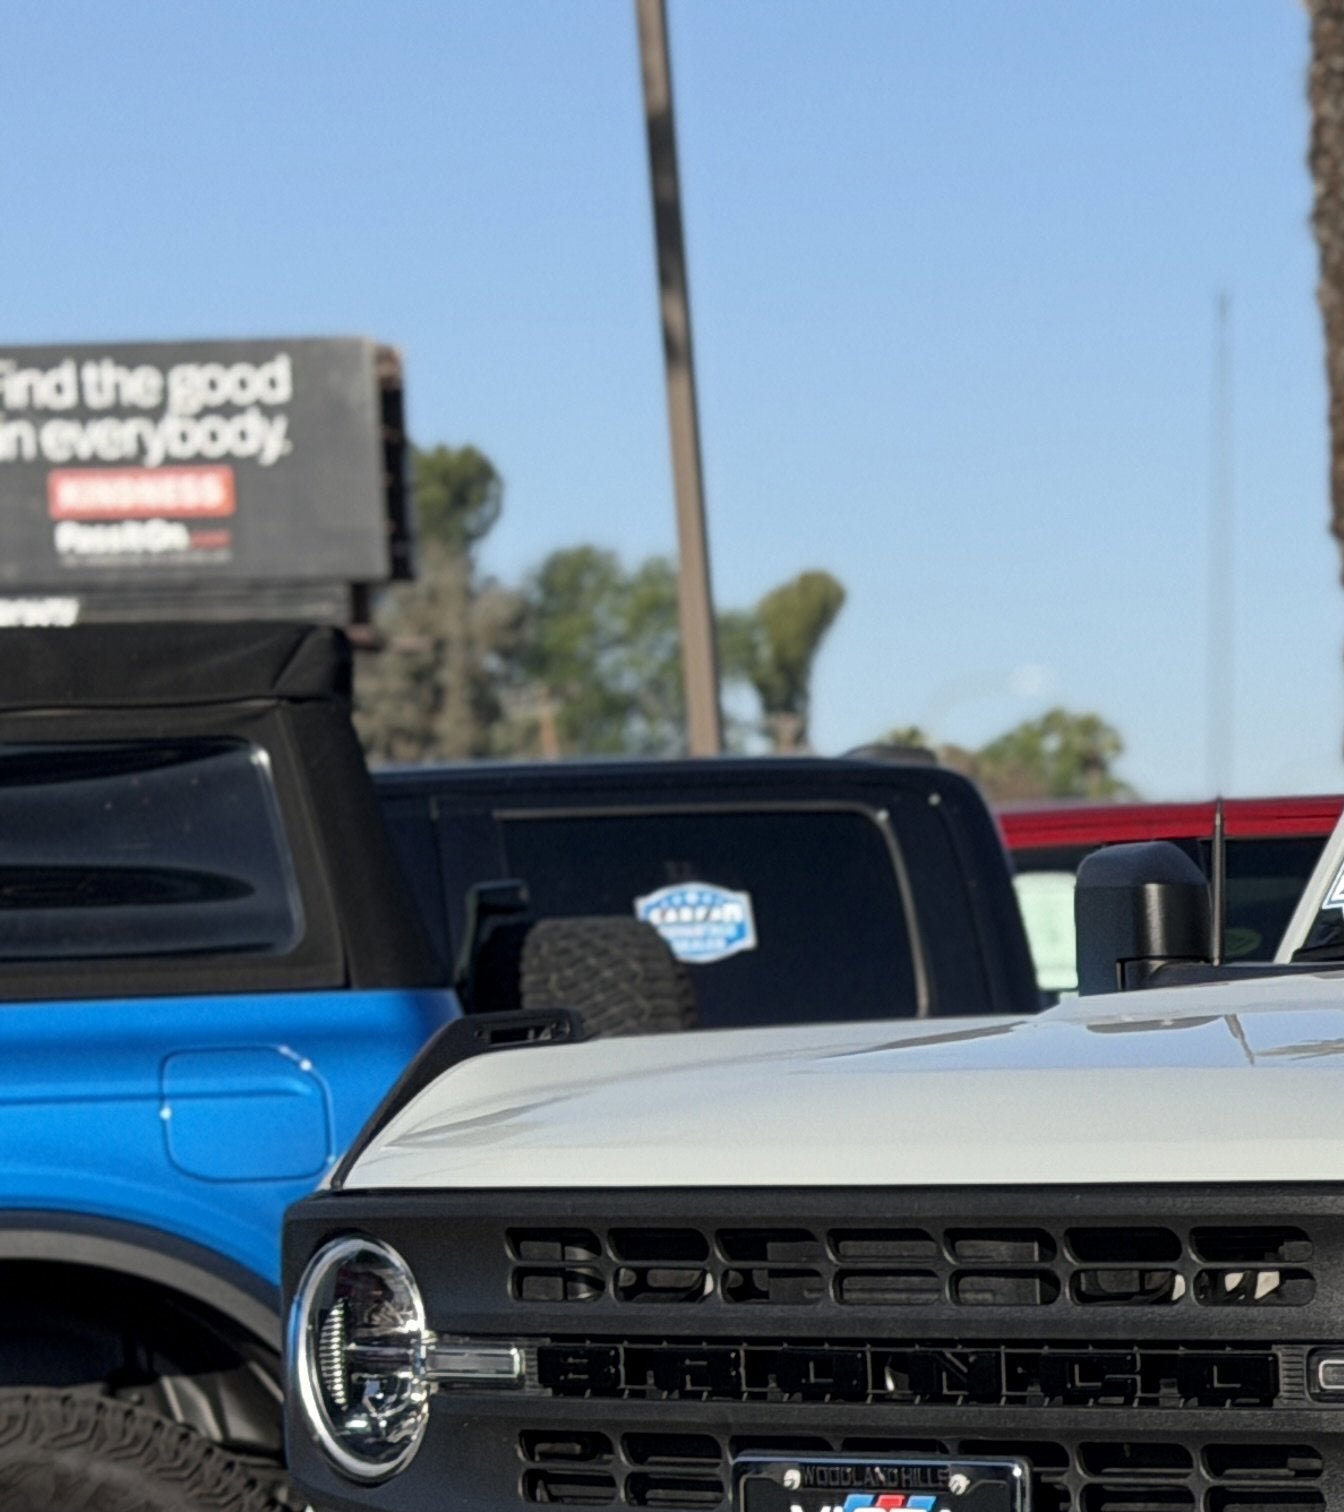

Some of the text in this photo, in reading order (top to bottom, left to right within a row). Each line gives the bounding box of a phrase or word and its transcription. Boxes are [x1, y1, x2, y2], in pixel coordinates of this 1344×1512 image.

[81, 356, 163, 409] the
[166, 352, 292, 417] good
[801, 1465, 950, 1487] WOODLAND HILLS
